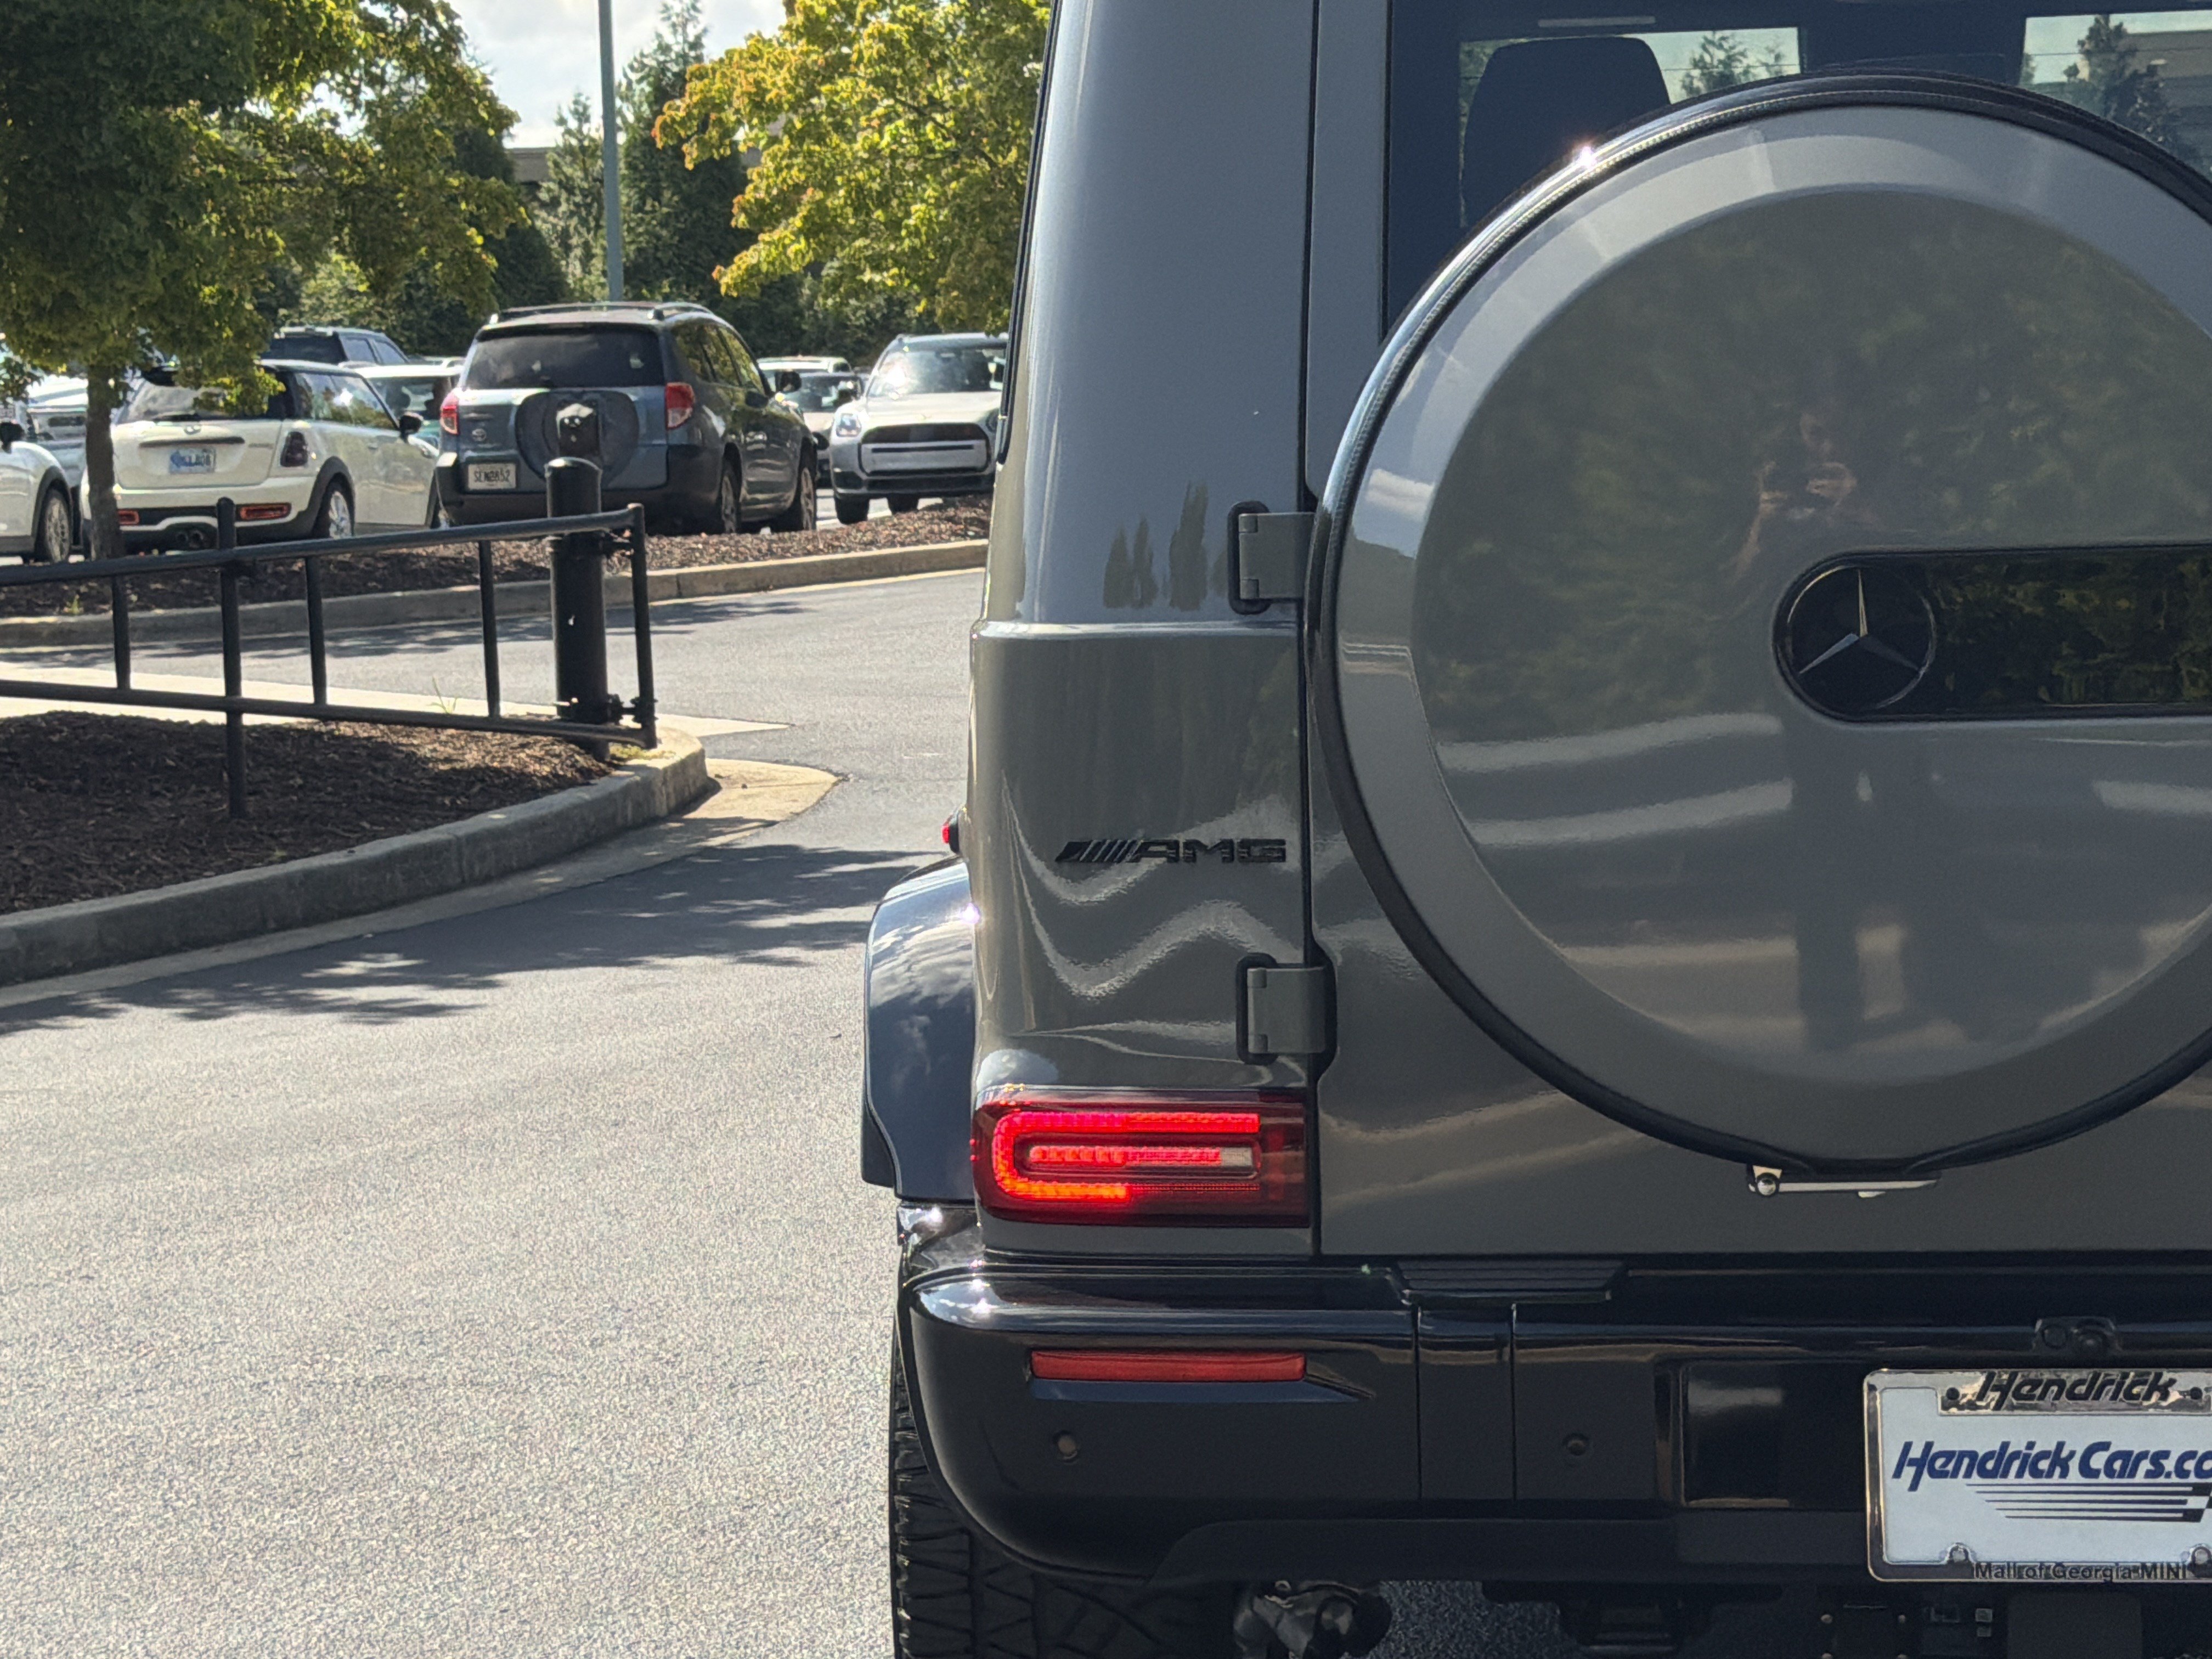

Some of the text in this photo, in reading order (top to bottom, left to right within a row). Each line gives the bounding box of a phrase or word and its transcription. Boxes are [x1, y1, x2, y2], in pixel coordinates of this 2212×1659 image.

[1125, 839, 1286, 863] AMG
[1975, 1371, 2177, 1412] Hendrick
[1975, 1561, 2187, 1584] Mall of Georgia MINI
